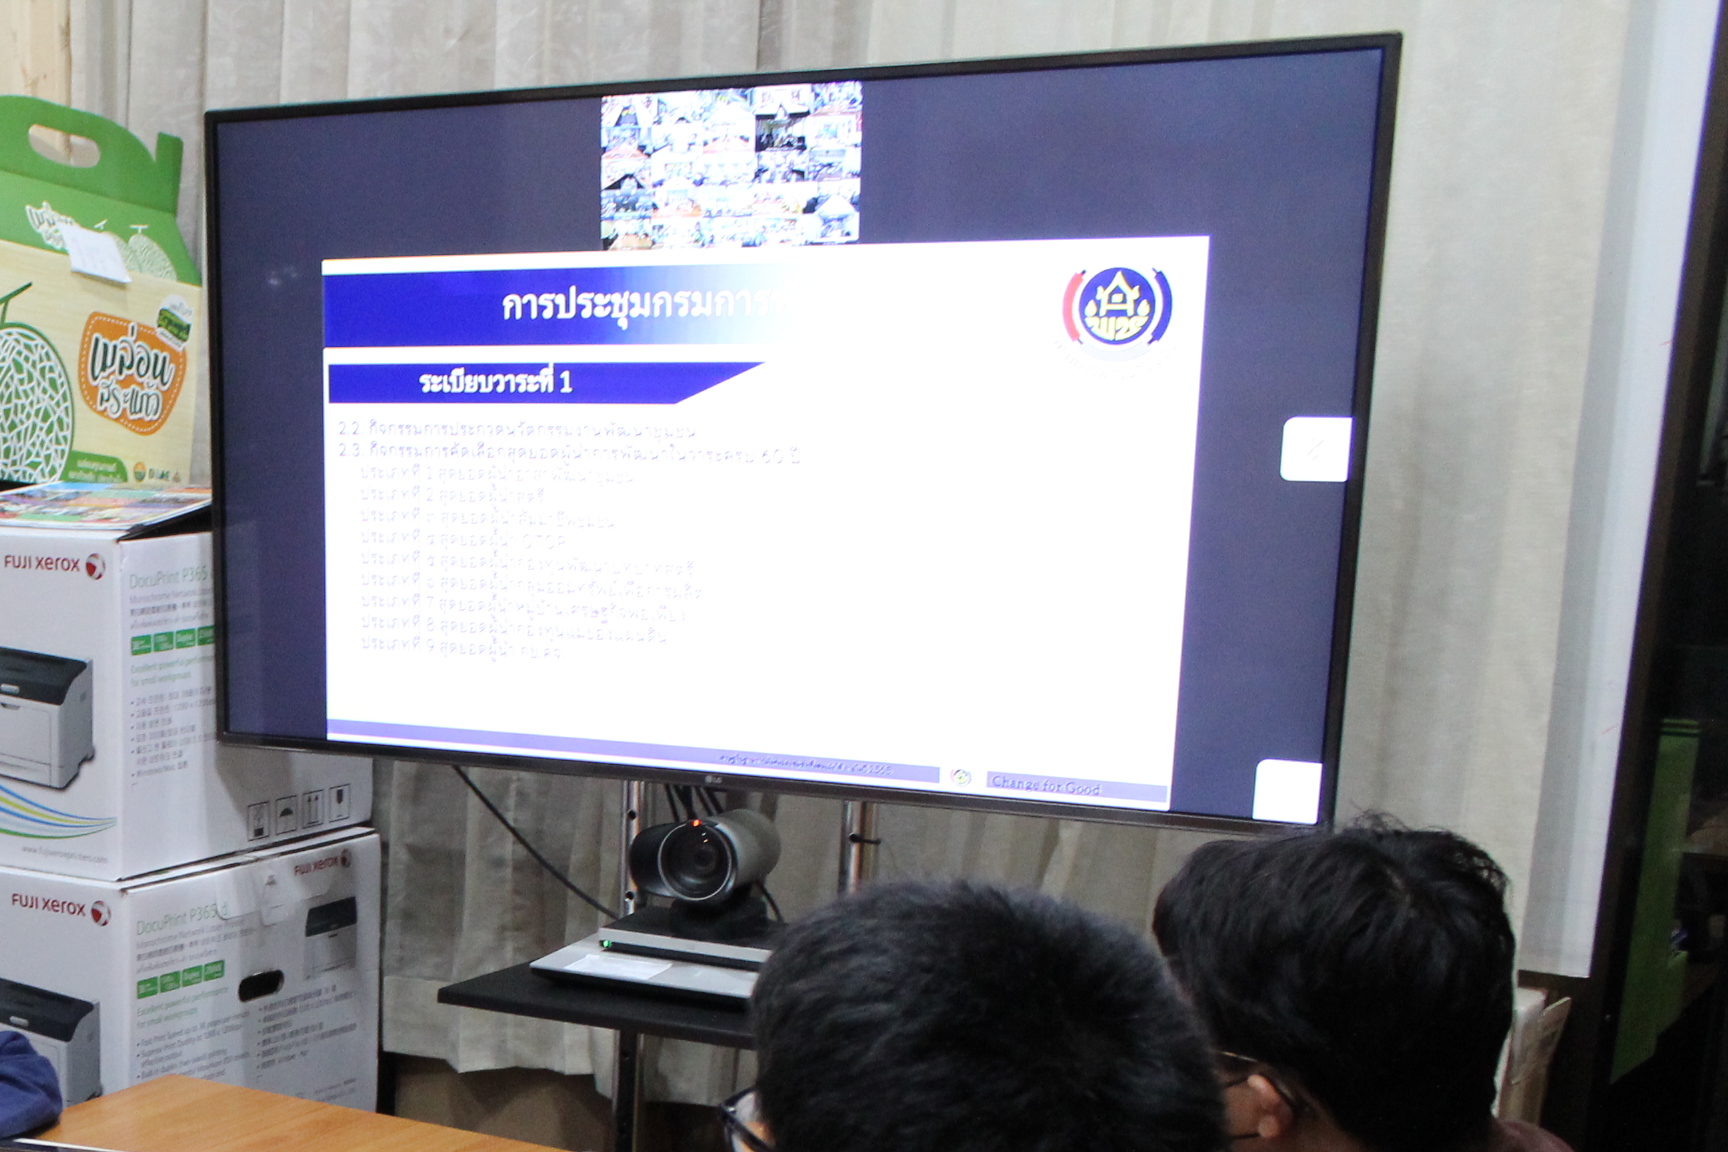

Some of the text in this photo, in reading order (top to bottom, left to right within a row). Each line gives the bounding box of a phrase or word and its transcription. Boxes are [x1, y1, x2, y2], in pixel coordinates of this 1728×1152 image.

[88, 322, 176, 391] เมล่อน
[419, 362, 573, 394] ระเบียบวาระที่ 1
[761, 449, 784, 464] 60
[4, 554, 80, 572] FUJI xerox
[991, 775, 1102, 796] Change for Good
[11, 893, 86, 917] FUJI xerox
